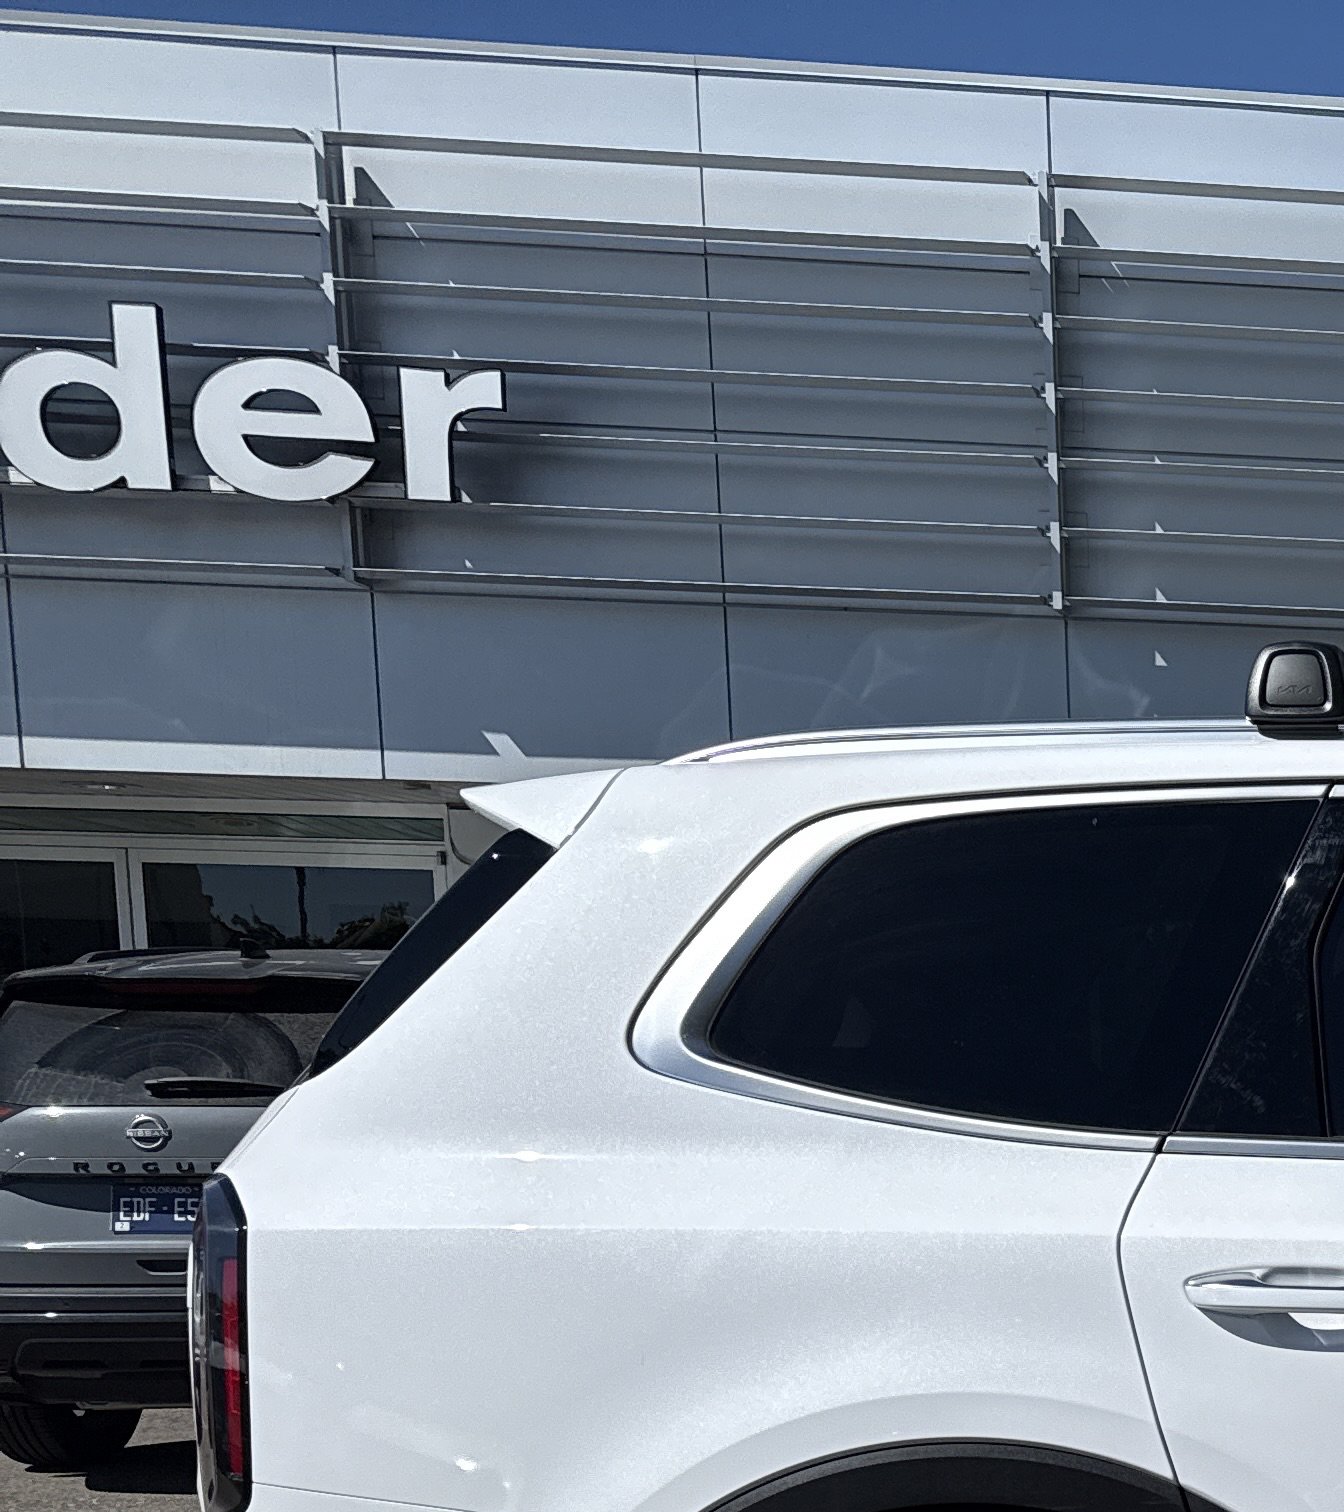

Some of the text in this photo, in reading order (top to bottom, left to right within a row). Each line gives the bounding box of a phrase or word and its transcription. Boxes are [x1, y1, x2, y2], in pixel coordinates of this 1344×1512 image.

[0, 301, 503, 502] der
[126, 1128, 170, 1138] NISSAN
[139, 1186, 192, 1194] COLORADO
